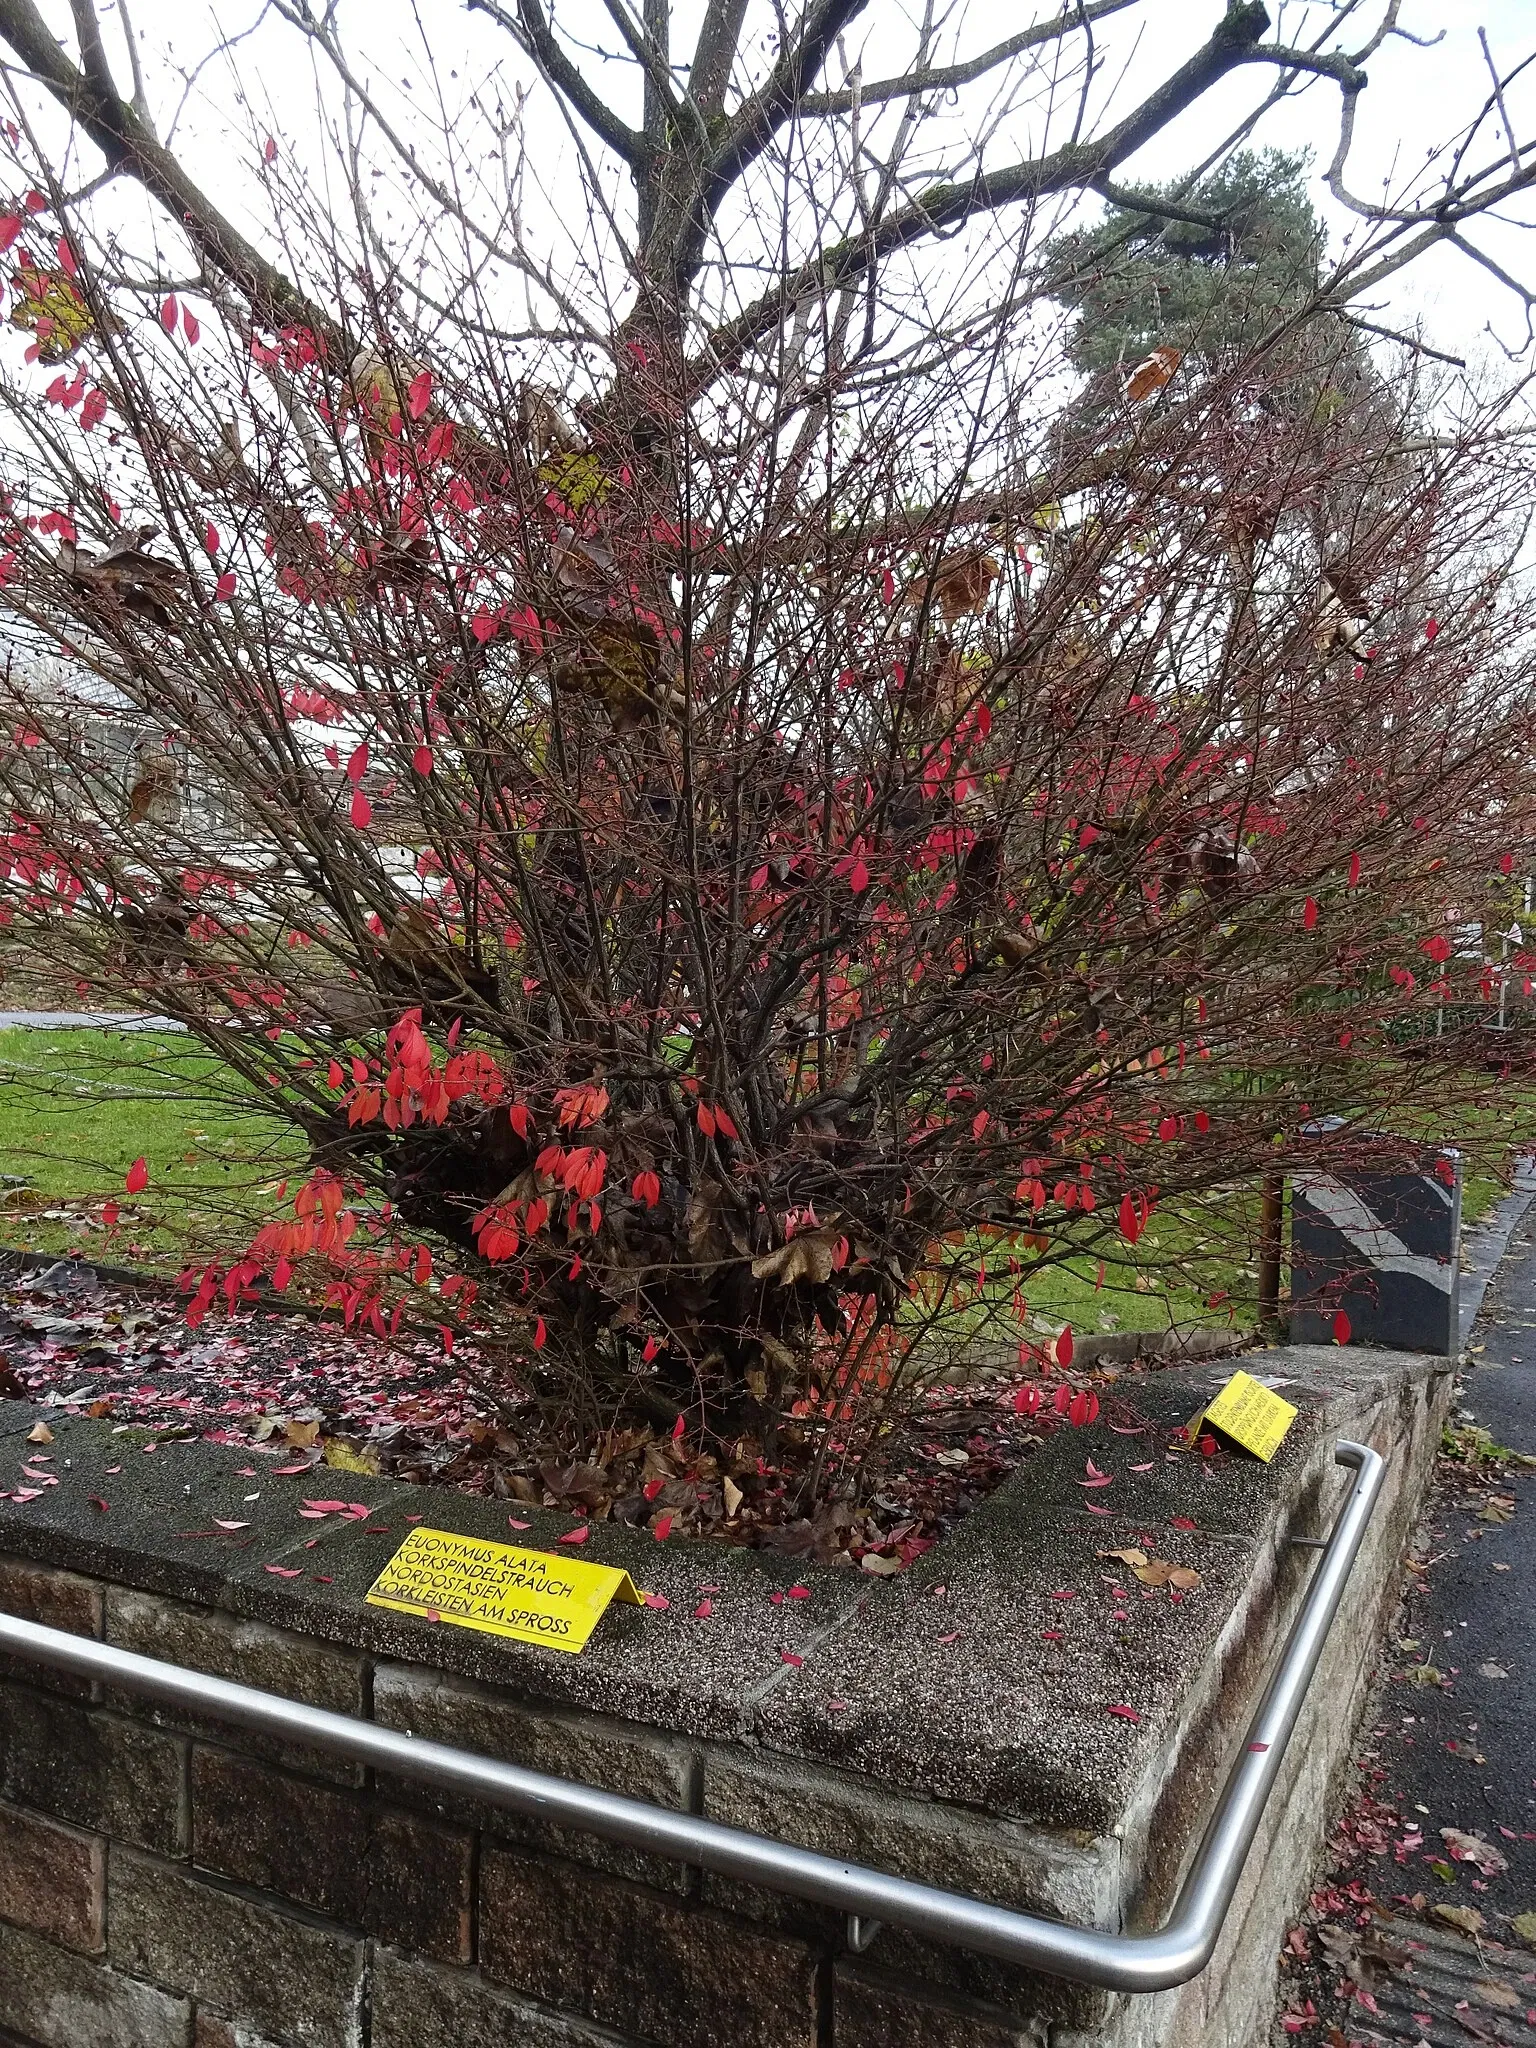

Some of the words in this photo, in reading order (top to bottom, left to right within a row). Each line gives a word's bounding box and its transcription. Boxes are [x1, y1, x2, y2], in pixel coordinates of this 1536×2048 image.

[395, 1550, 575, 1598] KORKSPINDELSTRAUCH
[405, 1534, 496, 1563] EUONYMUS
[494, 1554, 547, 1574] ALATA
[384, 1565, 508, 1600] NORDOSTASIEN
[373, 1579, 473, 1613] KORKLEISTEN
[474, 1601, 505, 1620] AM
[506, 1608, 573, 1634] SPROSS
